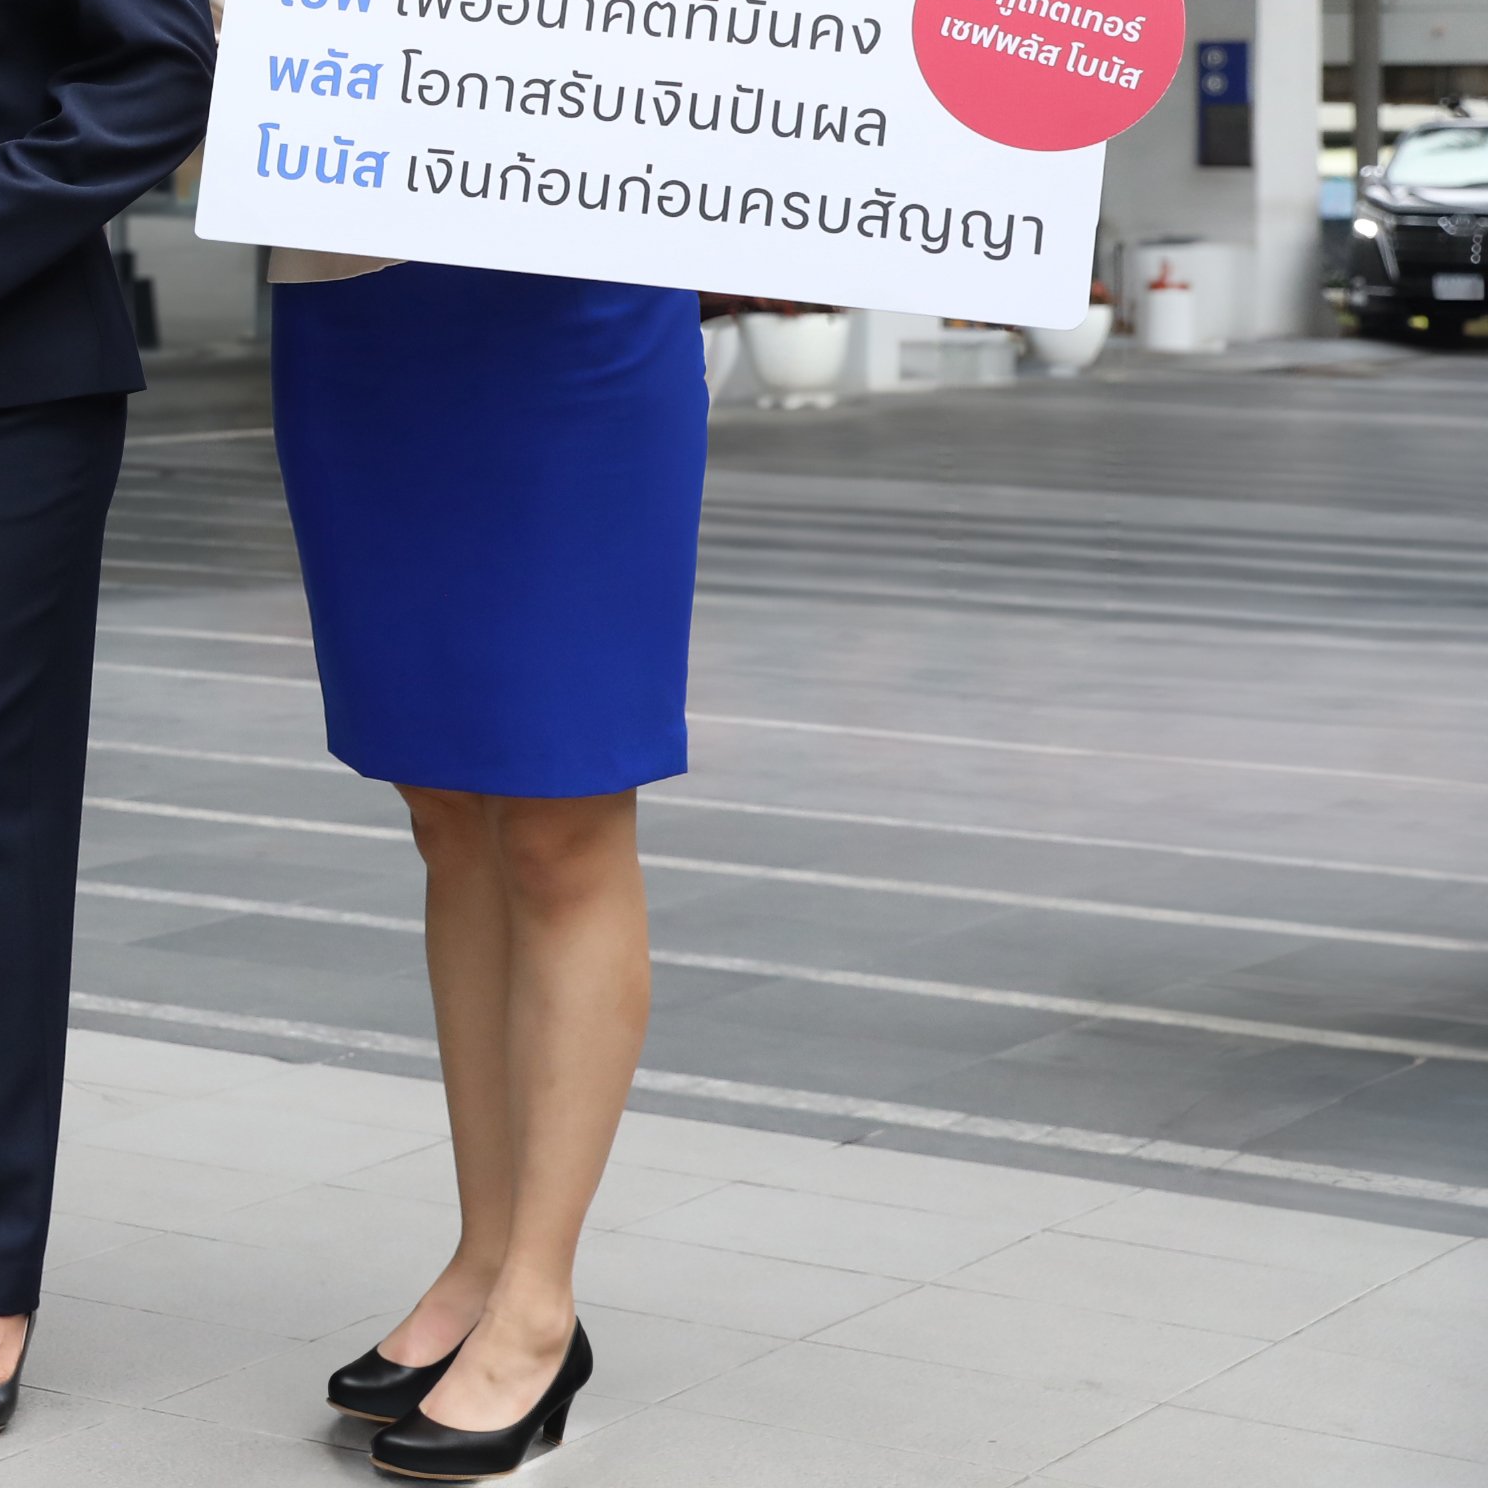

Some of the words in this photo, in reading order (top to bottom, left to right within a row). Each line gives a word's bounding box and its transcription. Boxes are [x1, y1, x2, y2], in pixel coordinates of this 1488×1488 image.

[269, 47, 385, 101] พลัส
[400, 48, 887, 148] โอกาสรับเงินปันผล
[940, 16, 1062, 67] เซฟพลัส
[1066, 41, 1144, 90] โบนัส
[256, 121, 391, 189] โบนัส
[407, 147, 1044, 262] เงินก้อนก่อนครบสัญญา
